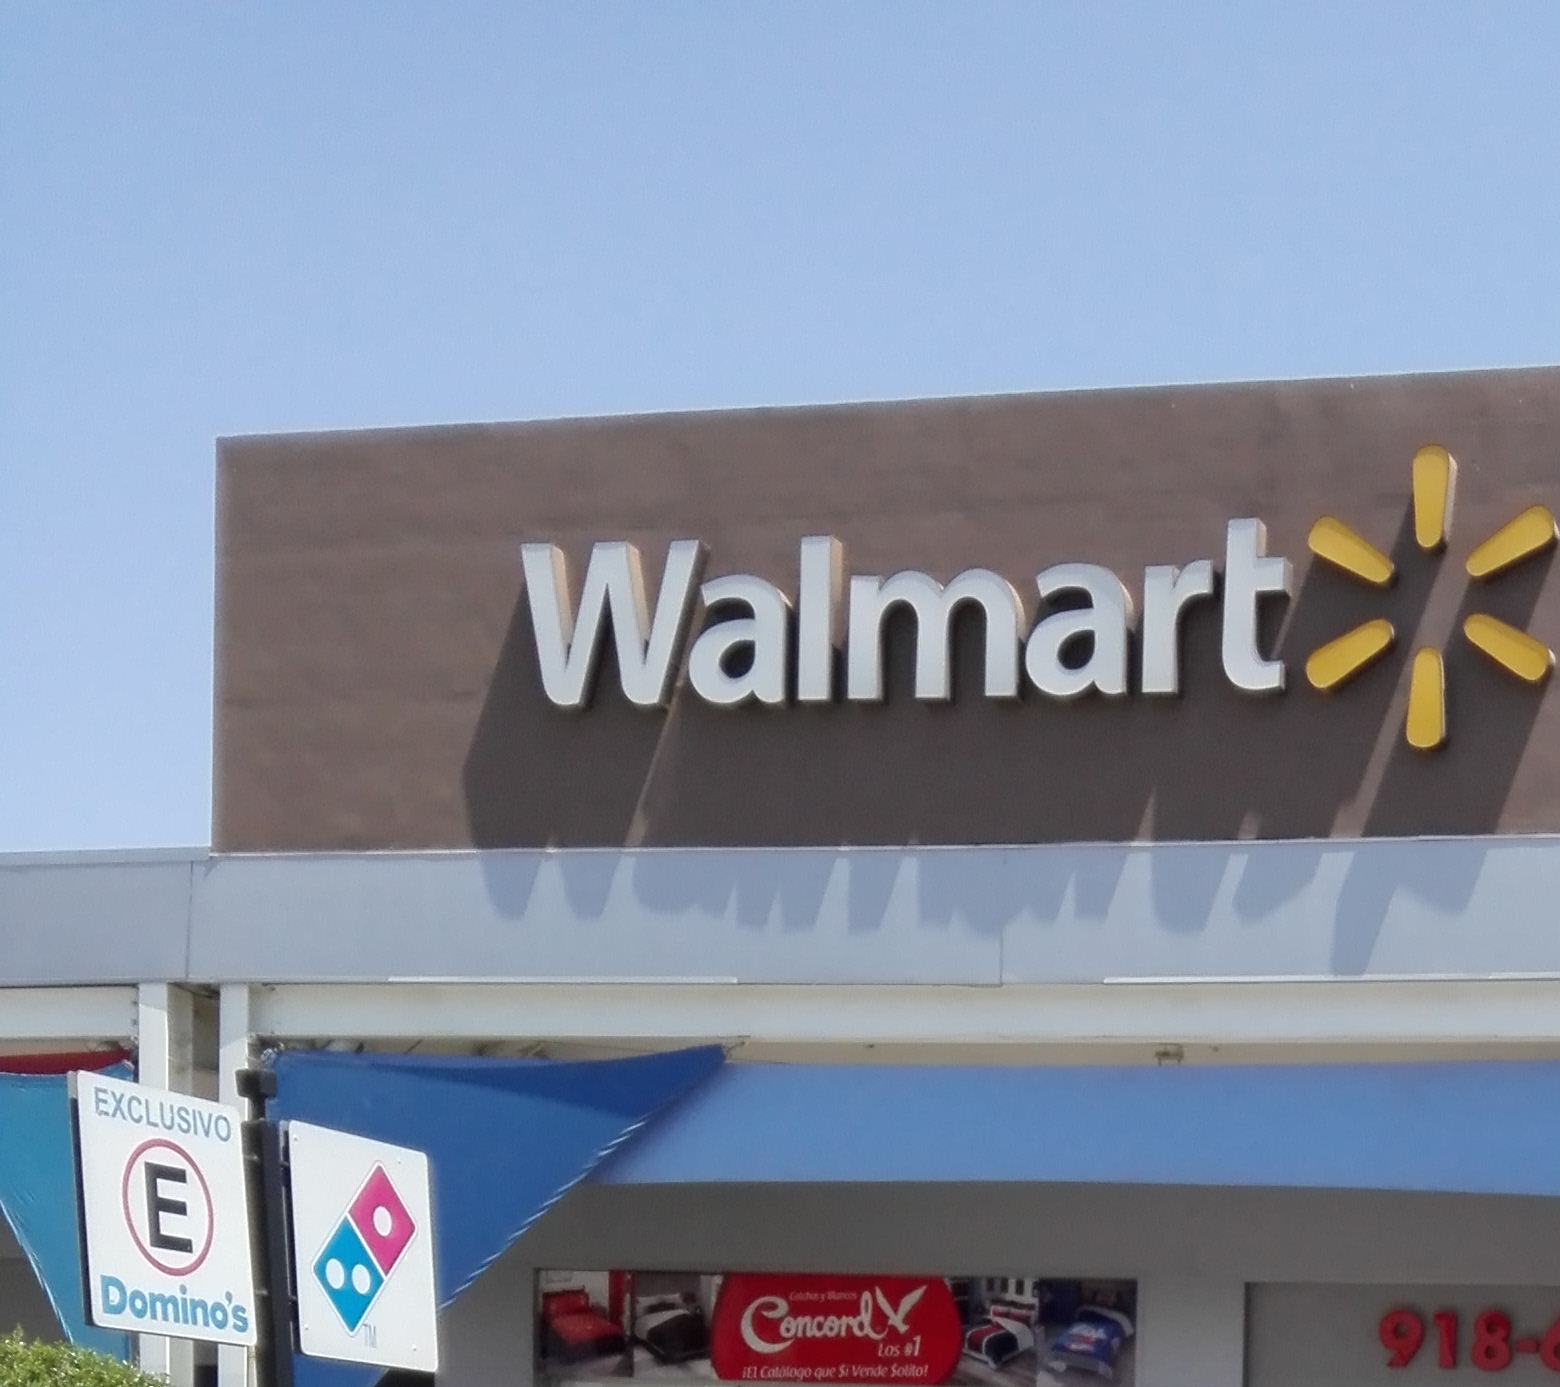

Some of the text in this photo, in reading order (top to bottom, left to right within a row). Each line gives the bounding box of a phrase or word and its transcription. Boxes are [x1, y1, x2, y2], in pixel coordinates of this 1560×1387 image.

[521, 516, 1293, 709] Walmart
[94, 1086, 232, 1142] EXCLUSIVO
[144, 1161, 194, 1254] E
[100, 1274, 249, 1333] Domino's
[814, 1368, 836, 1380] que
[878, 1343, 901, 1357] Los
